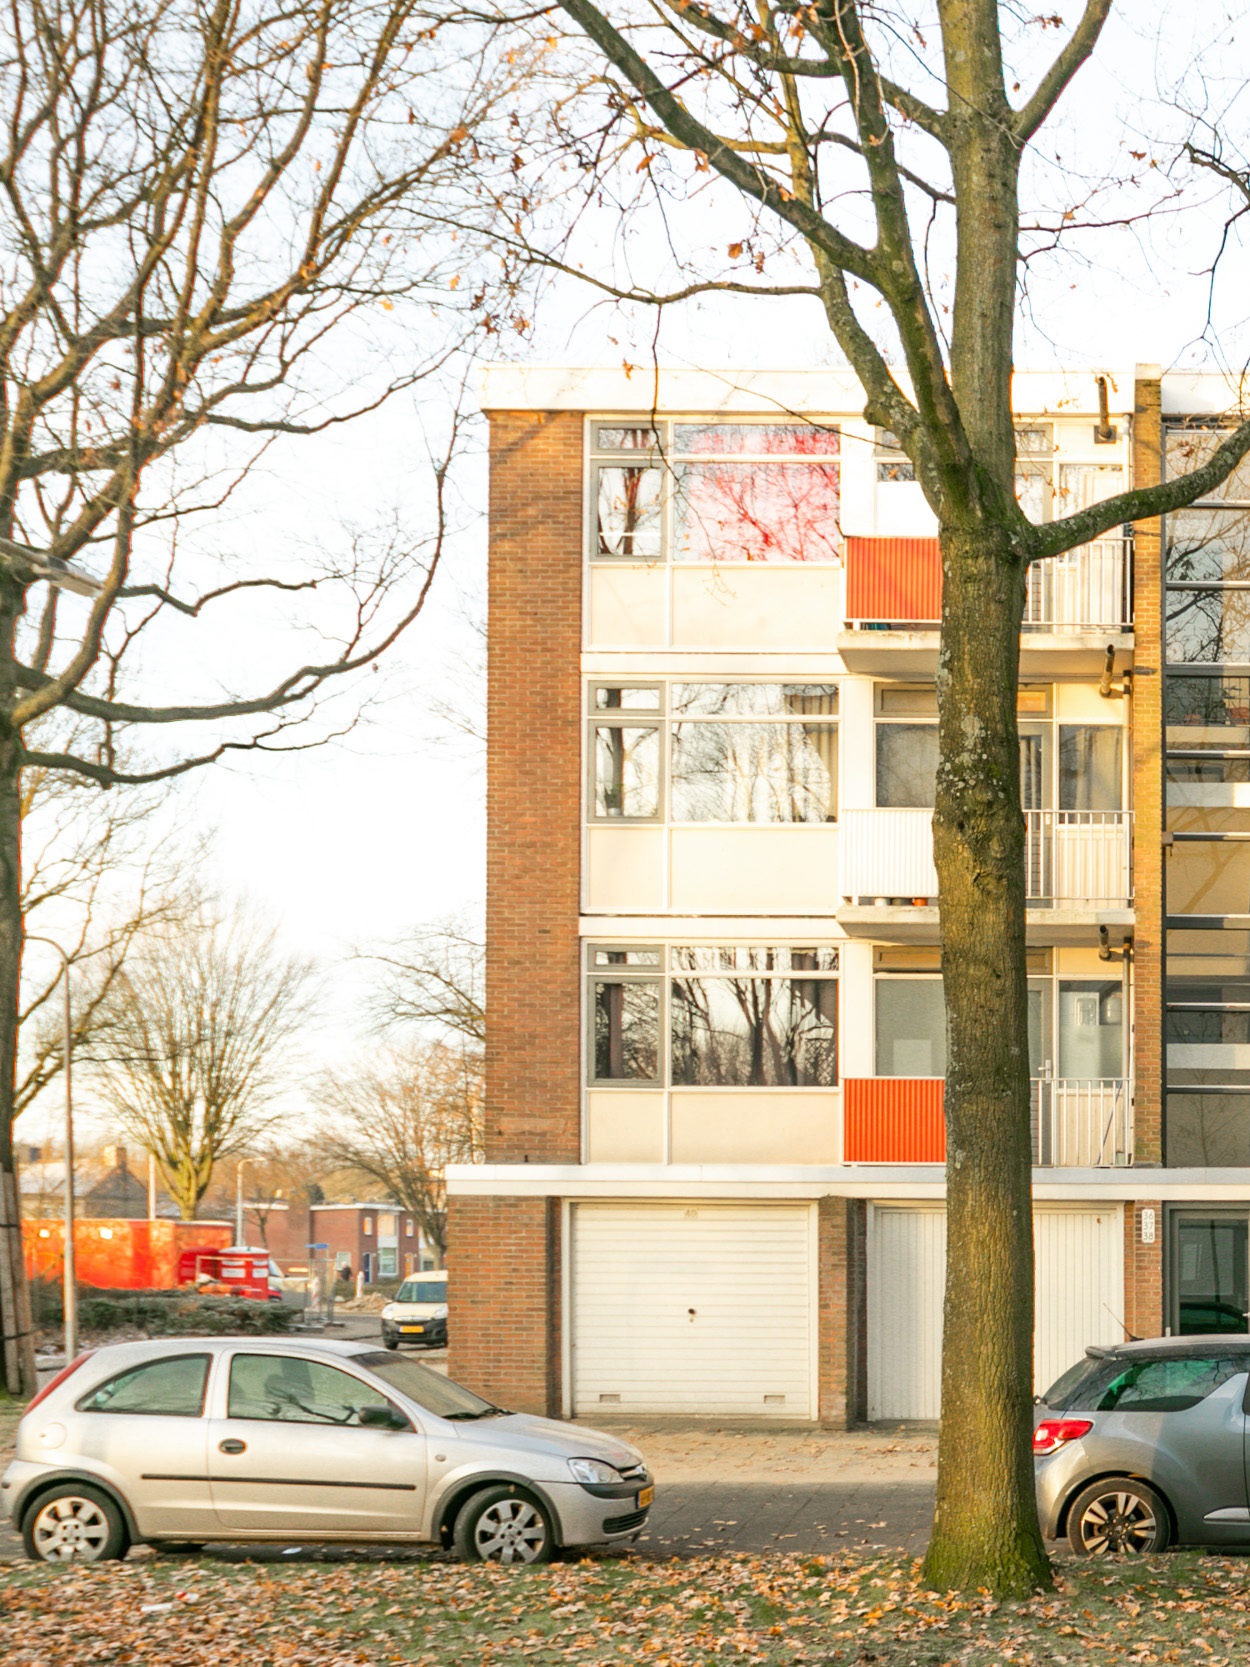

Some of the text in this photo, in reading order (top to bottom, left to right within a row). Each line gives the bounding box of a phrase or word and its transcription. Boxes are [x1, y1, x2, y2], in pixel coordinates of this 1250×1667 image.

[1143, 1211, 1154, 1220] 36
[1143, 1221, 1154, 1231] 37
[1143, 1232, 1154, 1241] 38
